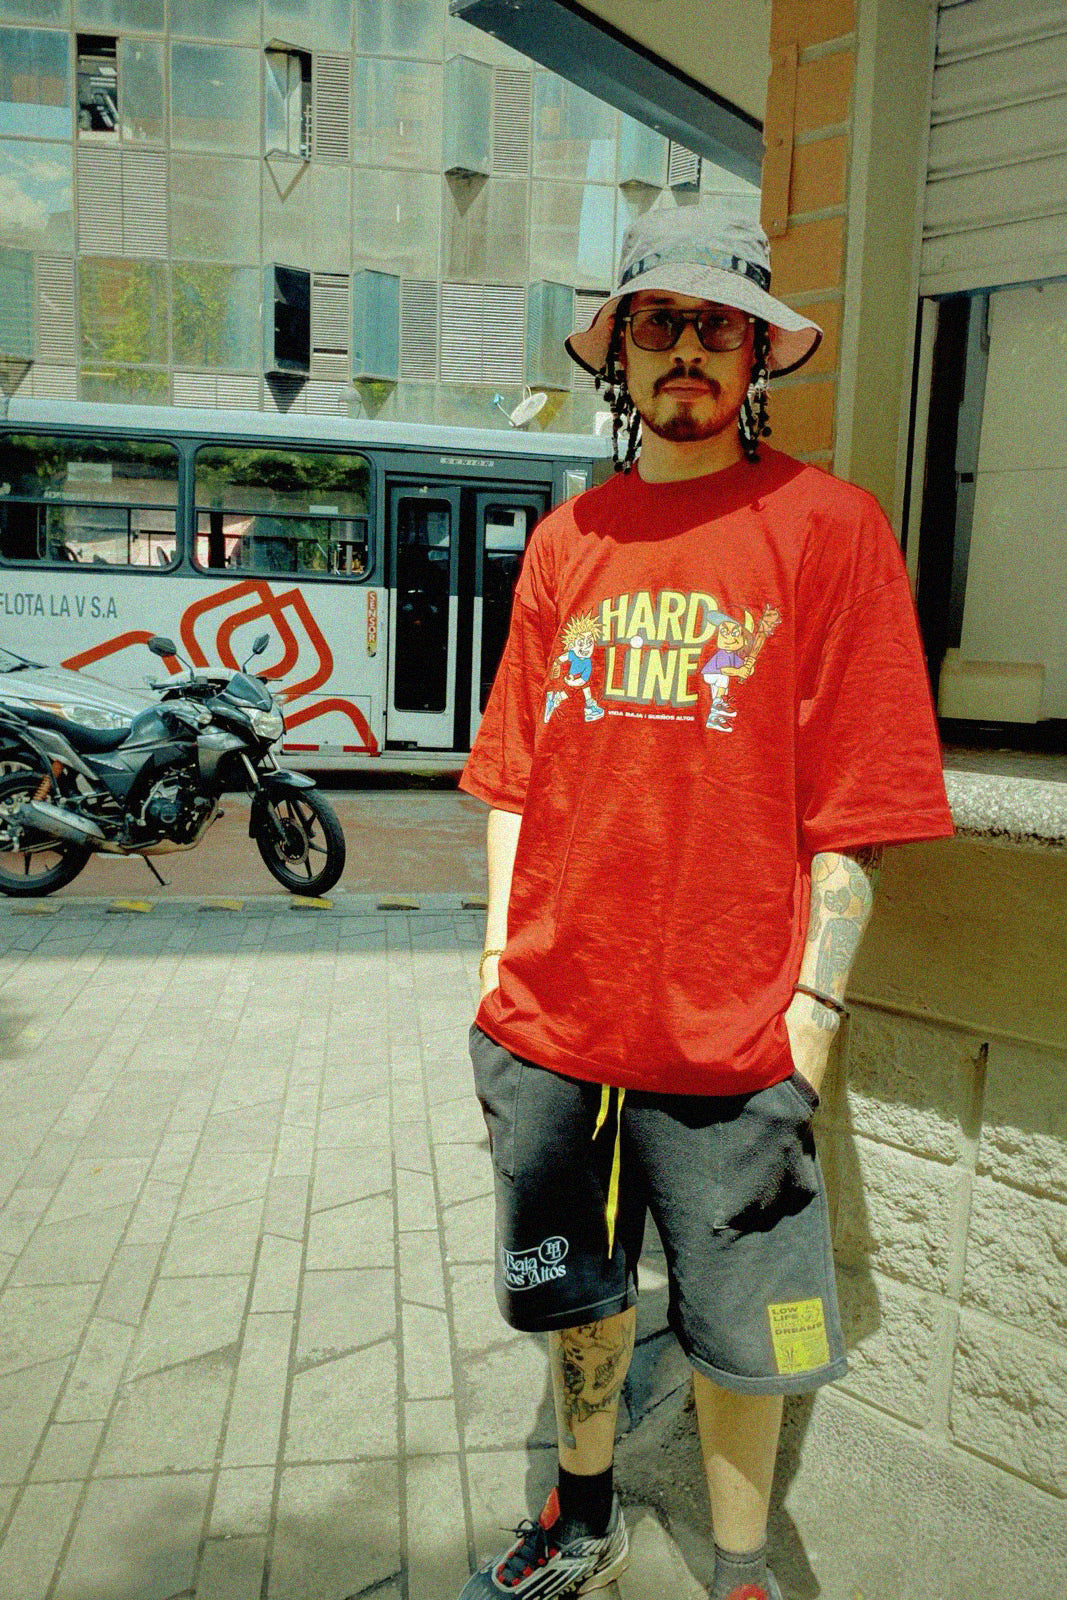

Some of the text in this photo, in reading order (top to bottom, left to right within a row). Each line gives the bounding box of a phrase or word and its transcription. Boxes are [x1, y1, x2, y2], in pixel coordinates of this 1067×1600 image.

[50, 594, 70, 617] LA
[75, 595, 85, 617] V
[91, 596, 117, 618] S.A
[368, 592, 376, 643] SENSOR
[600, 590, 719, 645] HARD
[604, 644, 702, 706] LINE
